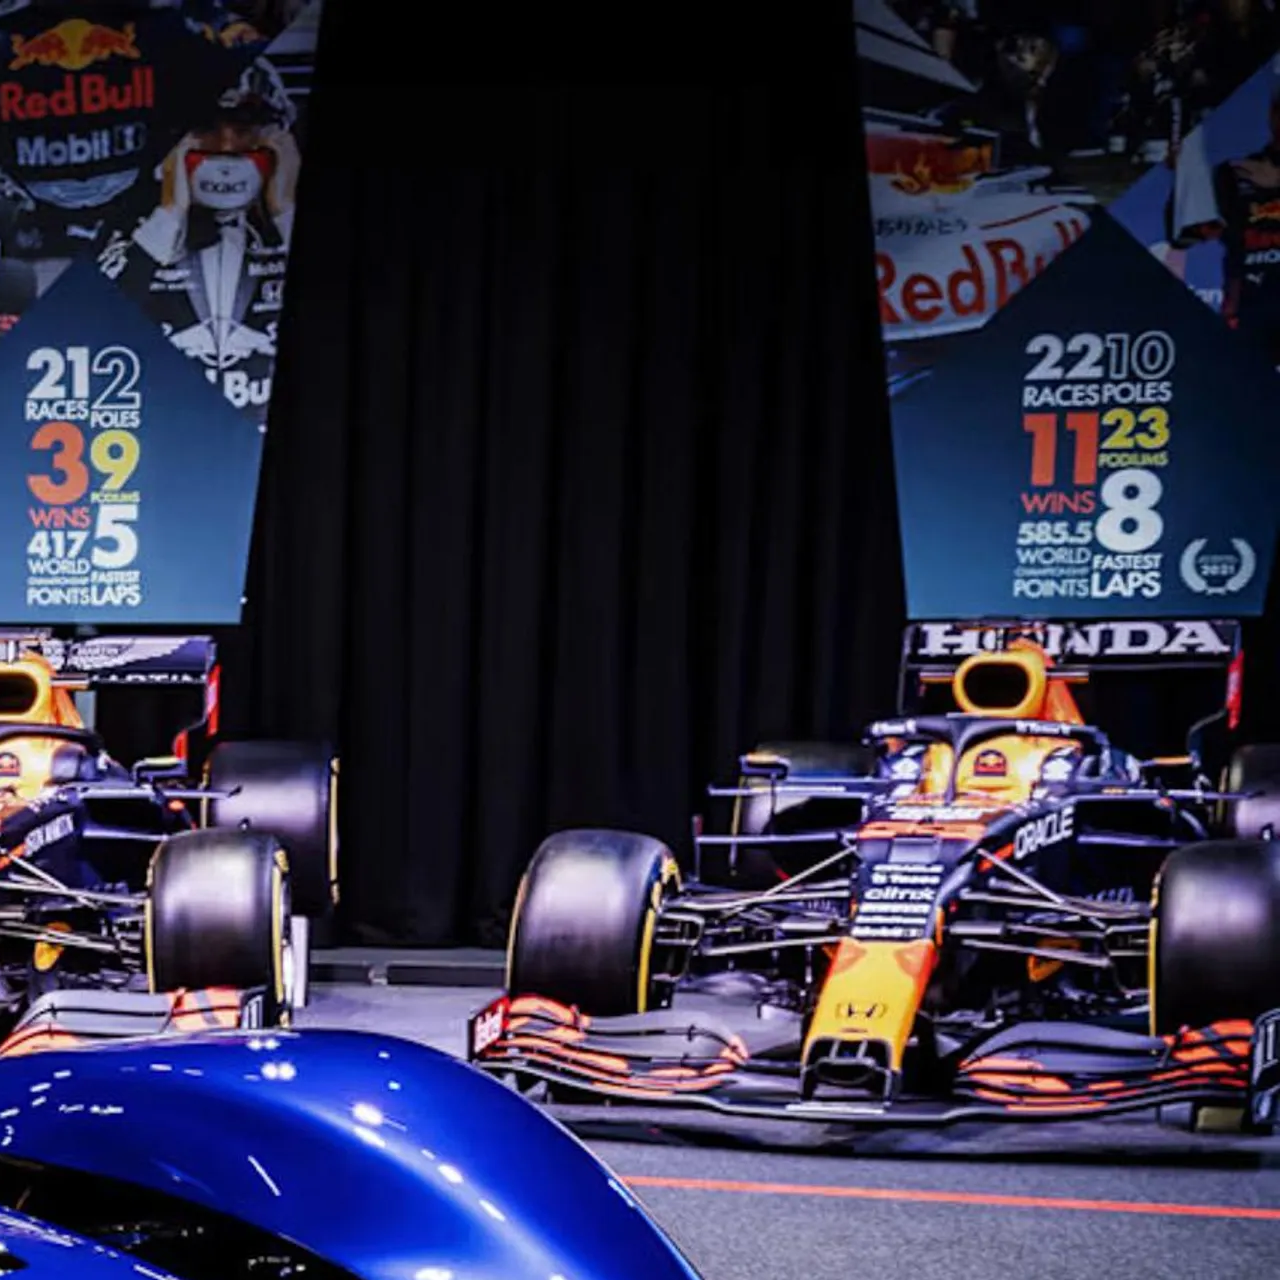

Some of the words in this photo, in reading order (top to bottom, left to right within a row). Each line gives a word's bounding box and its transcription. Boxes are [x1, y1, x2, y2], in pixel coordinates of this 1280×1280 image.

[80, 66, 155, 114] Bull
[16, 129, 111, 166] Mobil
[1024, 334, 1104, 380] 22
[1105, 330, 1175, 380] 10
[26, 347, 89, 400] 21
[91, 346, 141, 410] 2
[1023, 384, 1101, 408] RACES
[1102, 382, 1173, 404] POLES
[25, 400, 89, 420] RACES
[91, 411, 141, 428] POLES
[1100, 407, 1170, 450] 23
[27, 421, 89, 505] 3
[90, 429, 140, 490] 9
[1023, 411, 1099, 487] 11
[1020, 490, 1096, 515] WINS
[1095, 469, 1163, 553] 8
[28, 507, 91, 529] WINS
[27, 531, 90, 560] 417
[91, 503, 138, 569] 5
[1016, 522, 1093, 546] 585.5
[28, 558, 90, 575] WORLD
[1016, 547, 1091, 565] WORLD
[1092, 554, 1162, 570] FASTEST
[26, 587, 90, 607] POINTS
[91, 584, 141, 607] LAPS
[1012, 579, 1089, 598] POINTS
[1091, 571, 1161, 599] LAPS
[1014, 805, 1075, 860] ORACLE
